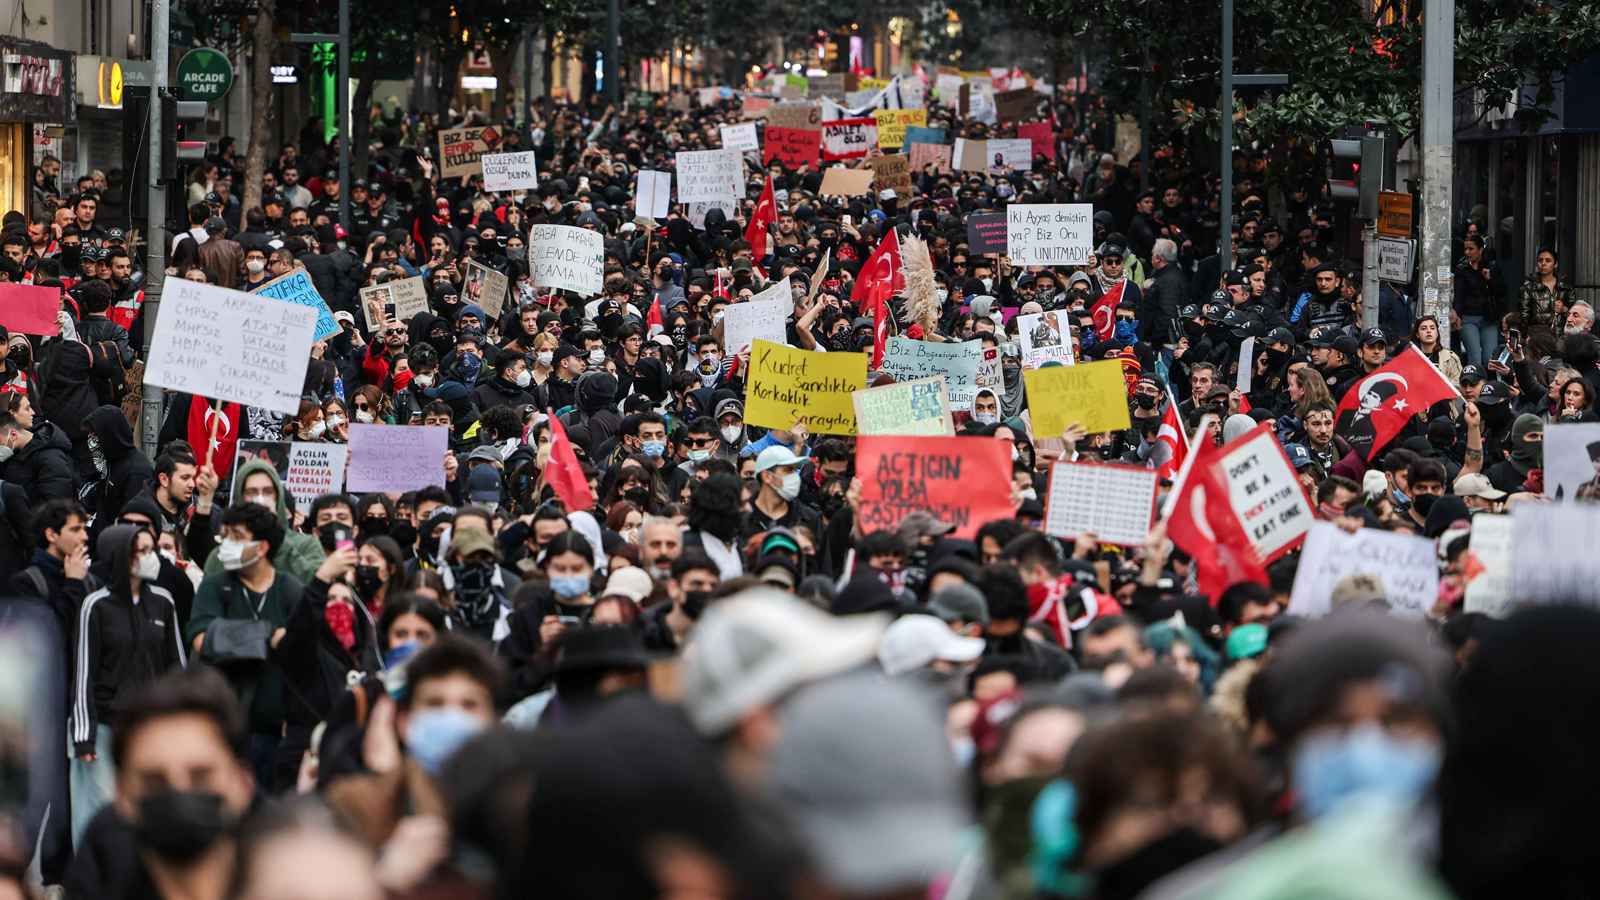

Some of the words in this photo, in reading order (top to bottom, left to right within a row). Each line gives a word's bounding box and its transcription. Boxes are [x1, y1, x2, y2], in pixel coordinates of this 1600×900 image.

[184, 73, 225, 82] ARCADE
[192, 84, 217, 93] CAFE
[1036, 227, 1053, 241] Biz
[759, 347, 808, 376] Kudret
[292, 459, 330, 467] YOLDAN
[1230, 454, 1260, 479] DON'T
[290, 468, 333, 477] MUSTAFA
[1244, 480, 1260, 496] BE
[1262, 474, 1271, 486] A
[1254, 518, 1277, 540] EAT
[1279, 503, 1301, 525] ONE
